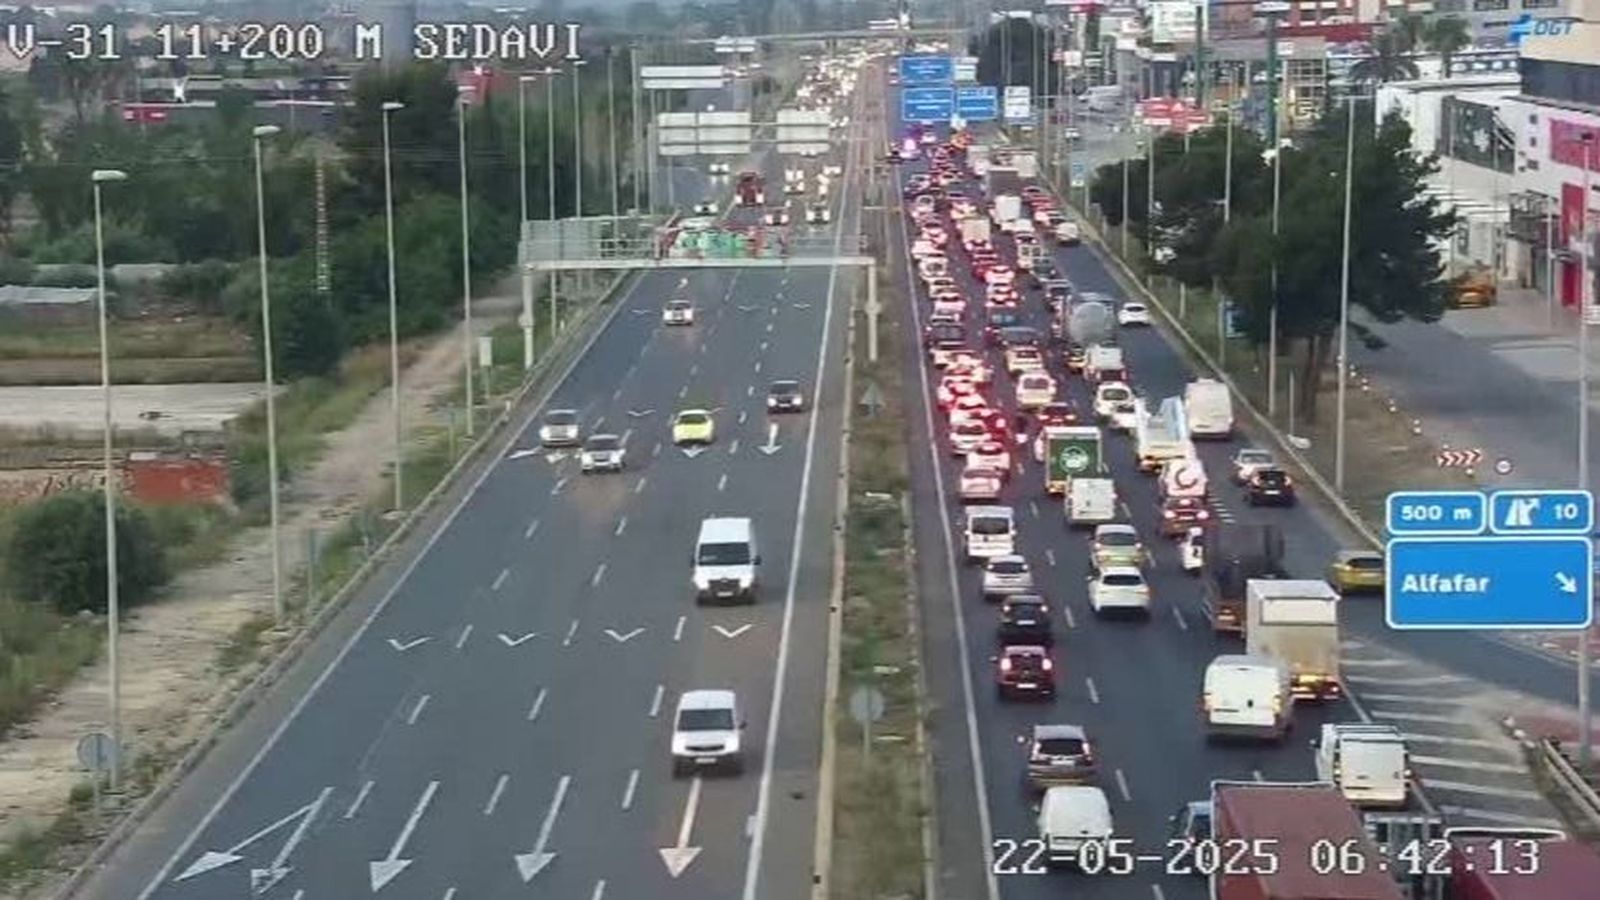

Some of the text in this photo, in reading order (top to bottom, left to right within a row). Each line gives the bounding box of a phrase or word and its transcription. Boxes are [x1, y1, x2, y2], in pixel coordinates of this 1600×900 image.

[1401, 504, 1473, 522] 500 m
[1554, 503, 1579, 520] 10
[1401, 573, 1490, 594] Alfafar
